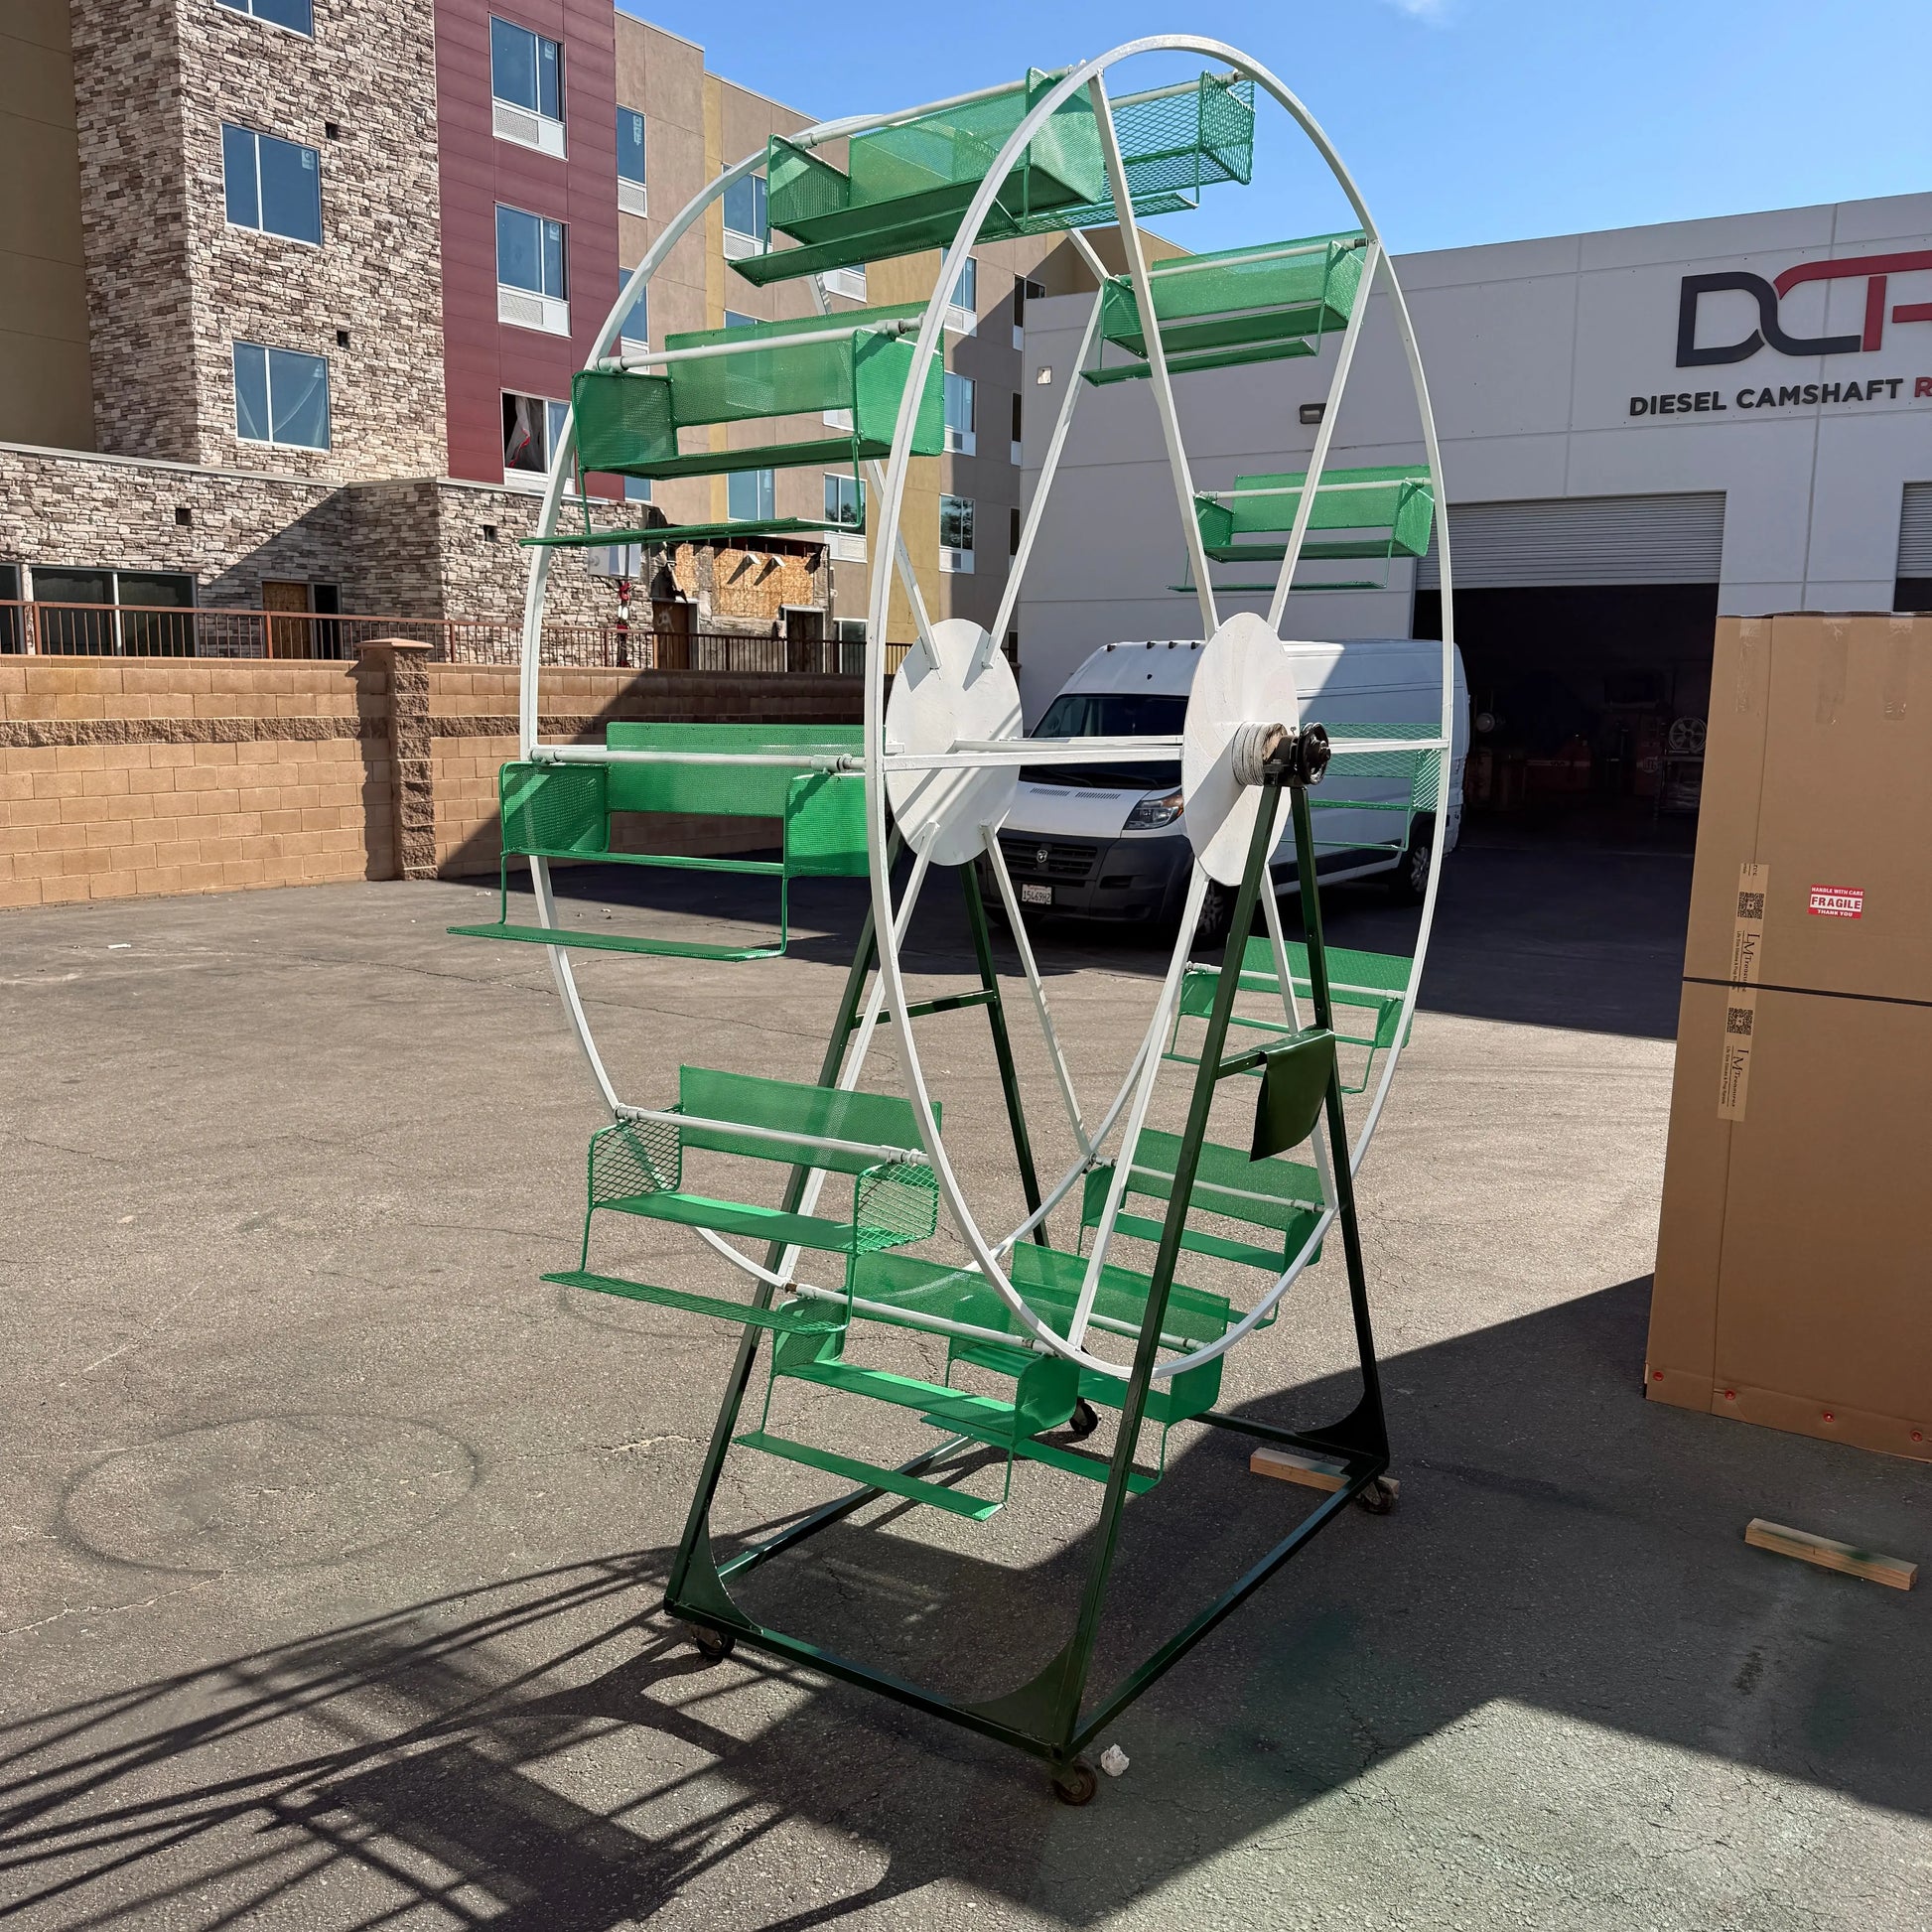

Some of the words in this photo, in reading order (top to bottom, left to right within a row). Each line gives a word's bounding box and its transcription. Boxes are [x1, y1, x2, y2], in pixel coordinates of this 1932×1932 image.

[1629, 391, 1727, 417] DIESEL
[1736, 378, 1904, 409] CAMSHAFT
[1811, 897, 1862, 910] FRAGILE
